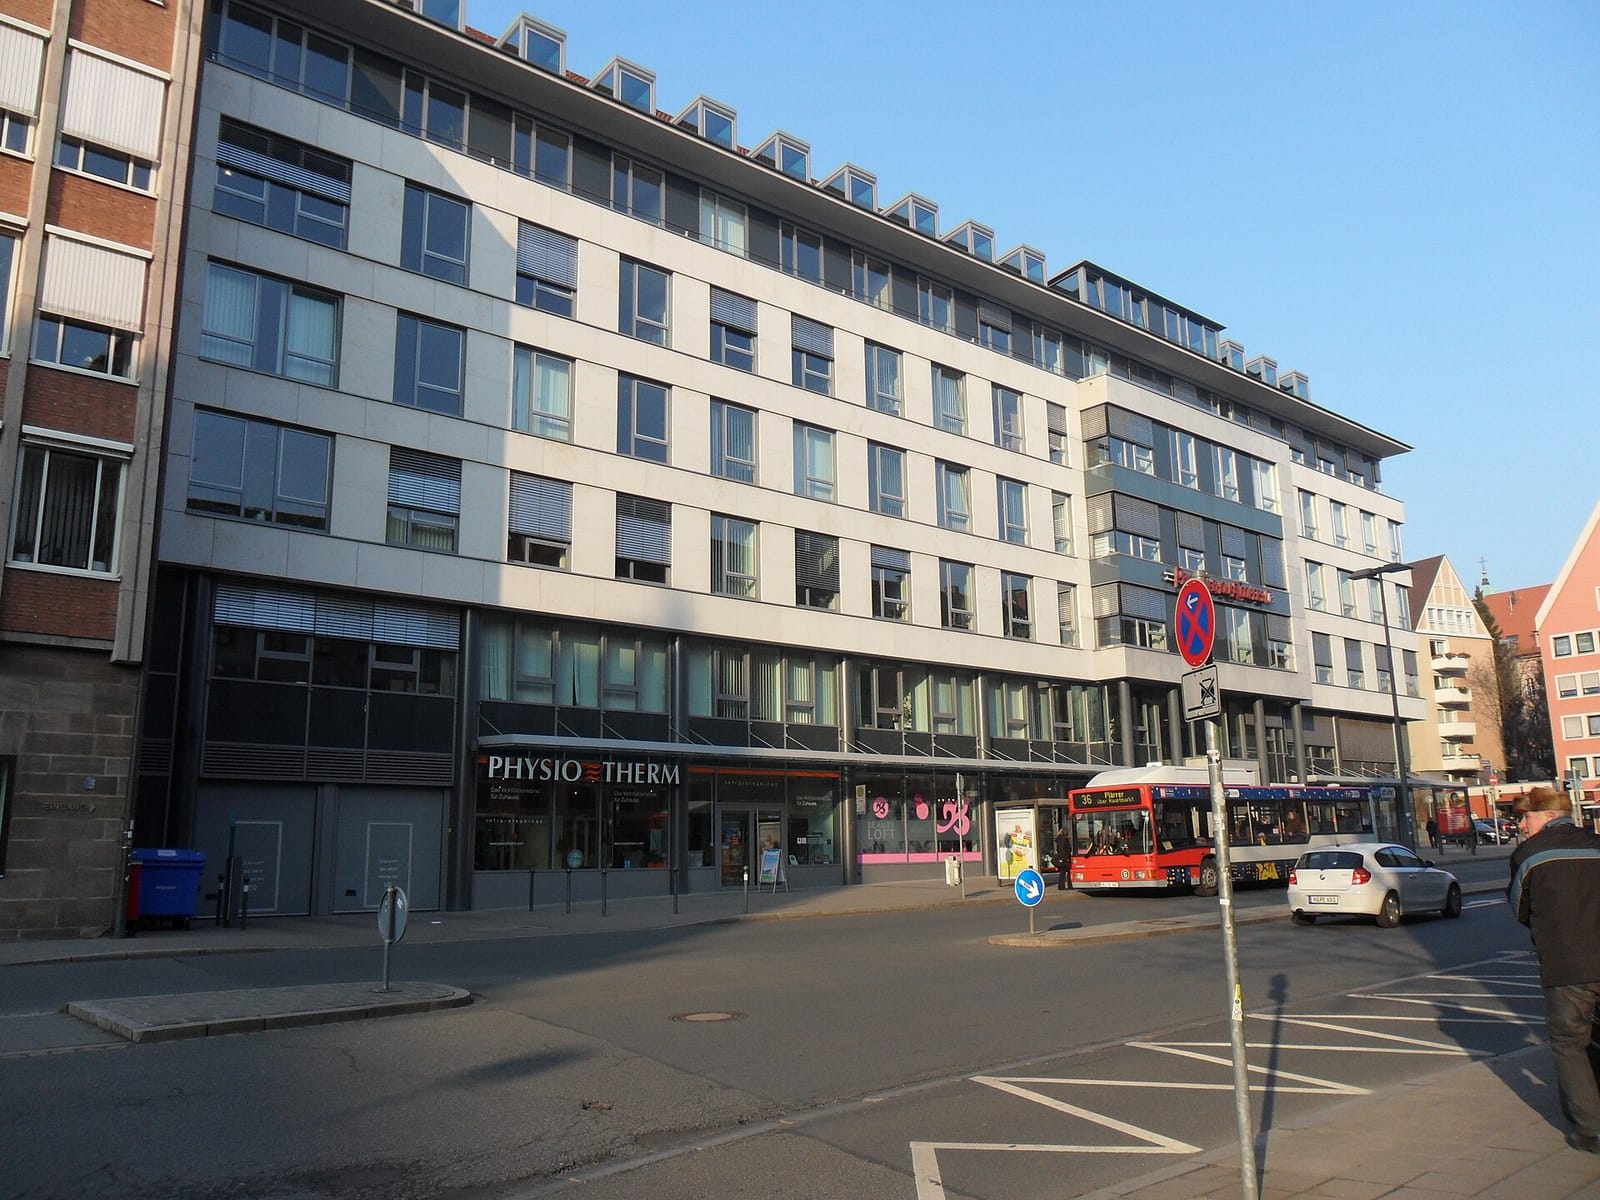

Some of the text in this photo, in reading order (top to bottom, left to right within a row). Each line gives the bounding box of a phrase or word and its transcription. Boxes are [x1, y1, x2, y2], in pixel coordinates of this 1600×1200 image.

[488, 756, 680, 785] PHYSIO THERM
[1081, 794, 1092, 805] 36
[867, 821, 895, 829] BEAUTY
[867, 829, 896, 840] LOFT
